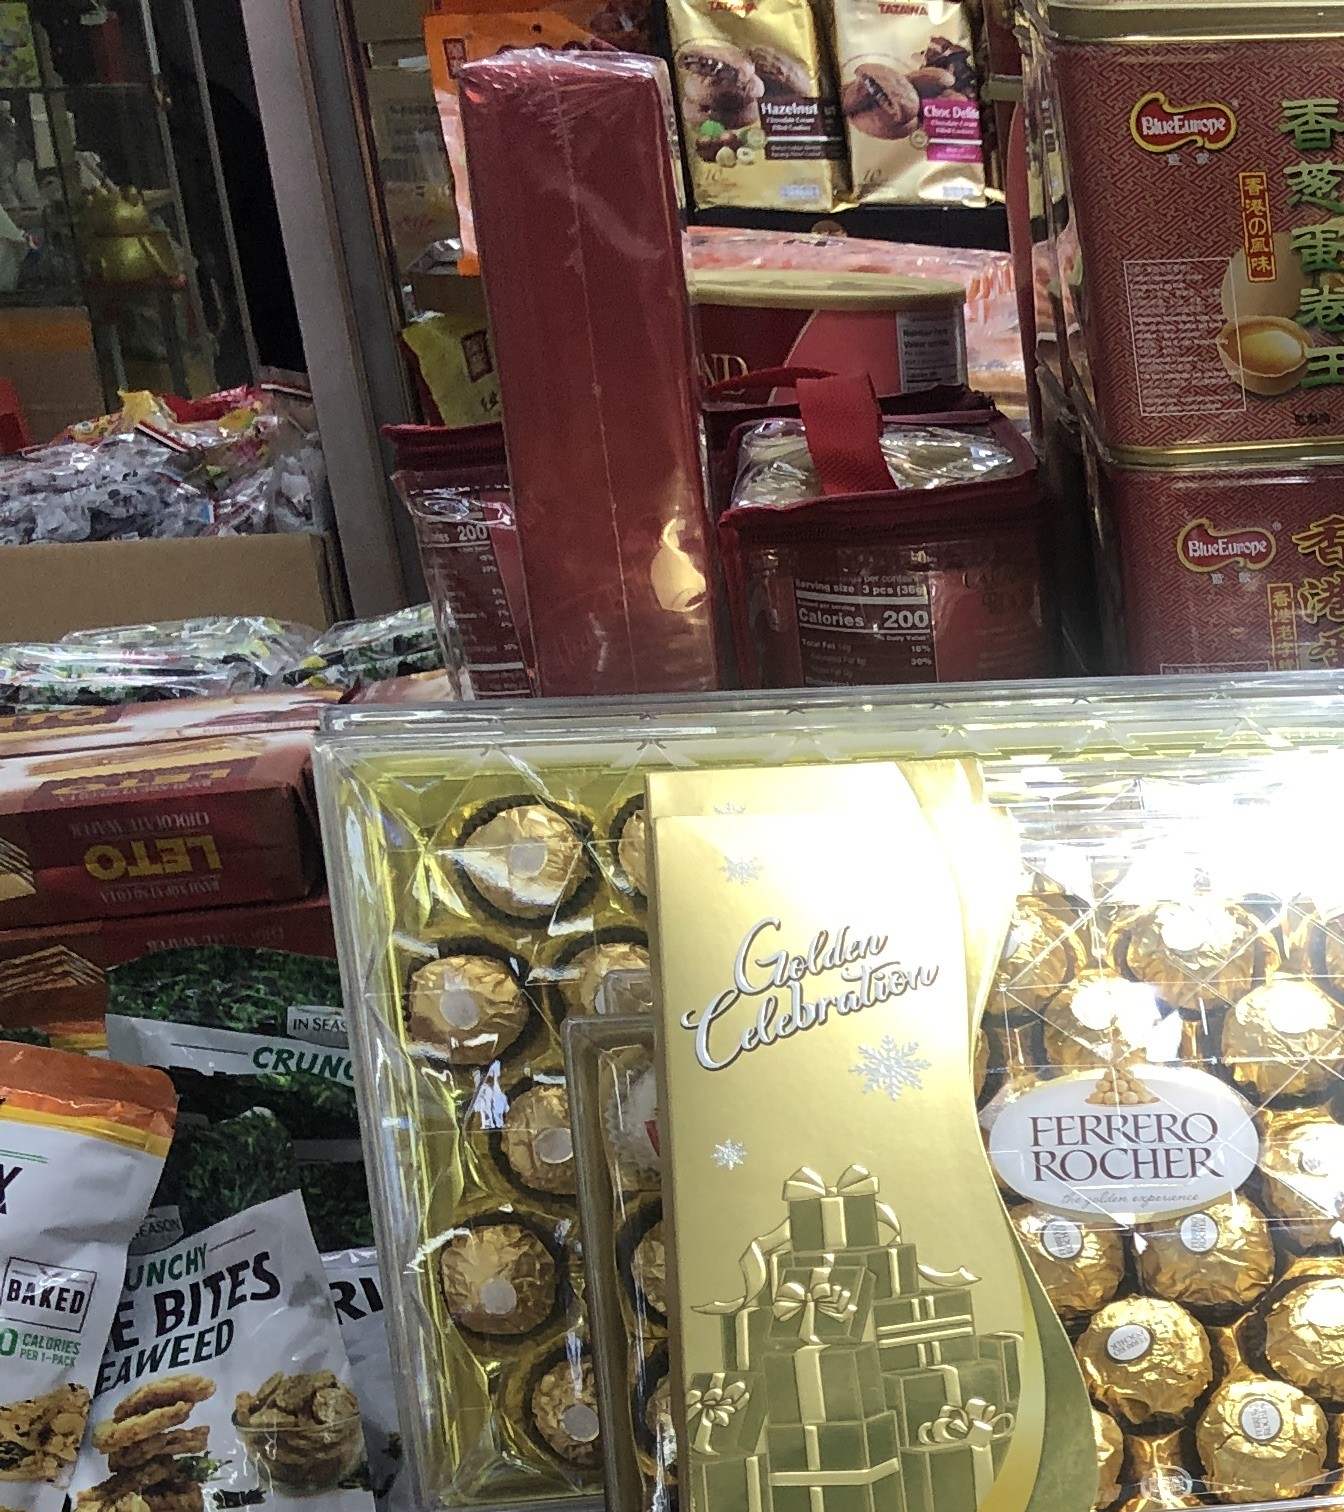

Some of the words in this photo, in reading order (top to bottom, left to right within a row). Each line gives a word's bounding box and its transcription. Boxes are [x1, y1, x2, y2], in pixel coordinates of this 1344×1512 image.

[1187, 538, 1268, 559] BlueEurope
[799, 608, 864, 628] Calories
[883, 611, 928, 628] 200
[84, 834, 224, 881] LETO
[733, 916, 889, 995] Golden
[293, 1018, 307, 1033] IN
[680, 955, 941, 1072] Celebration
[1028, 1112, 1219, 1153] FERRERO
[1033, 1143, 1225, 1185] ROCHER
[125, 1242, 208, 1292] UNCHY
[7, 1281, 86, 1316] BAKED
[155, 1251, 282, 1334] BITES
[21, 1335, 82, 1358] CALORIES
[98, 1317, 235, 1393] EAWEED
